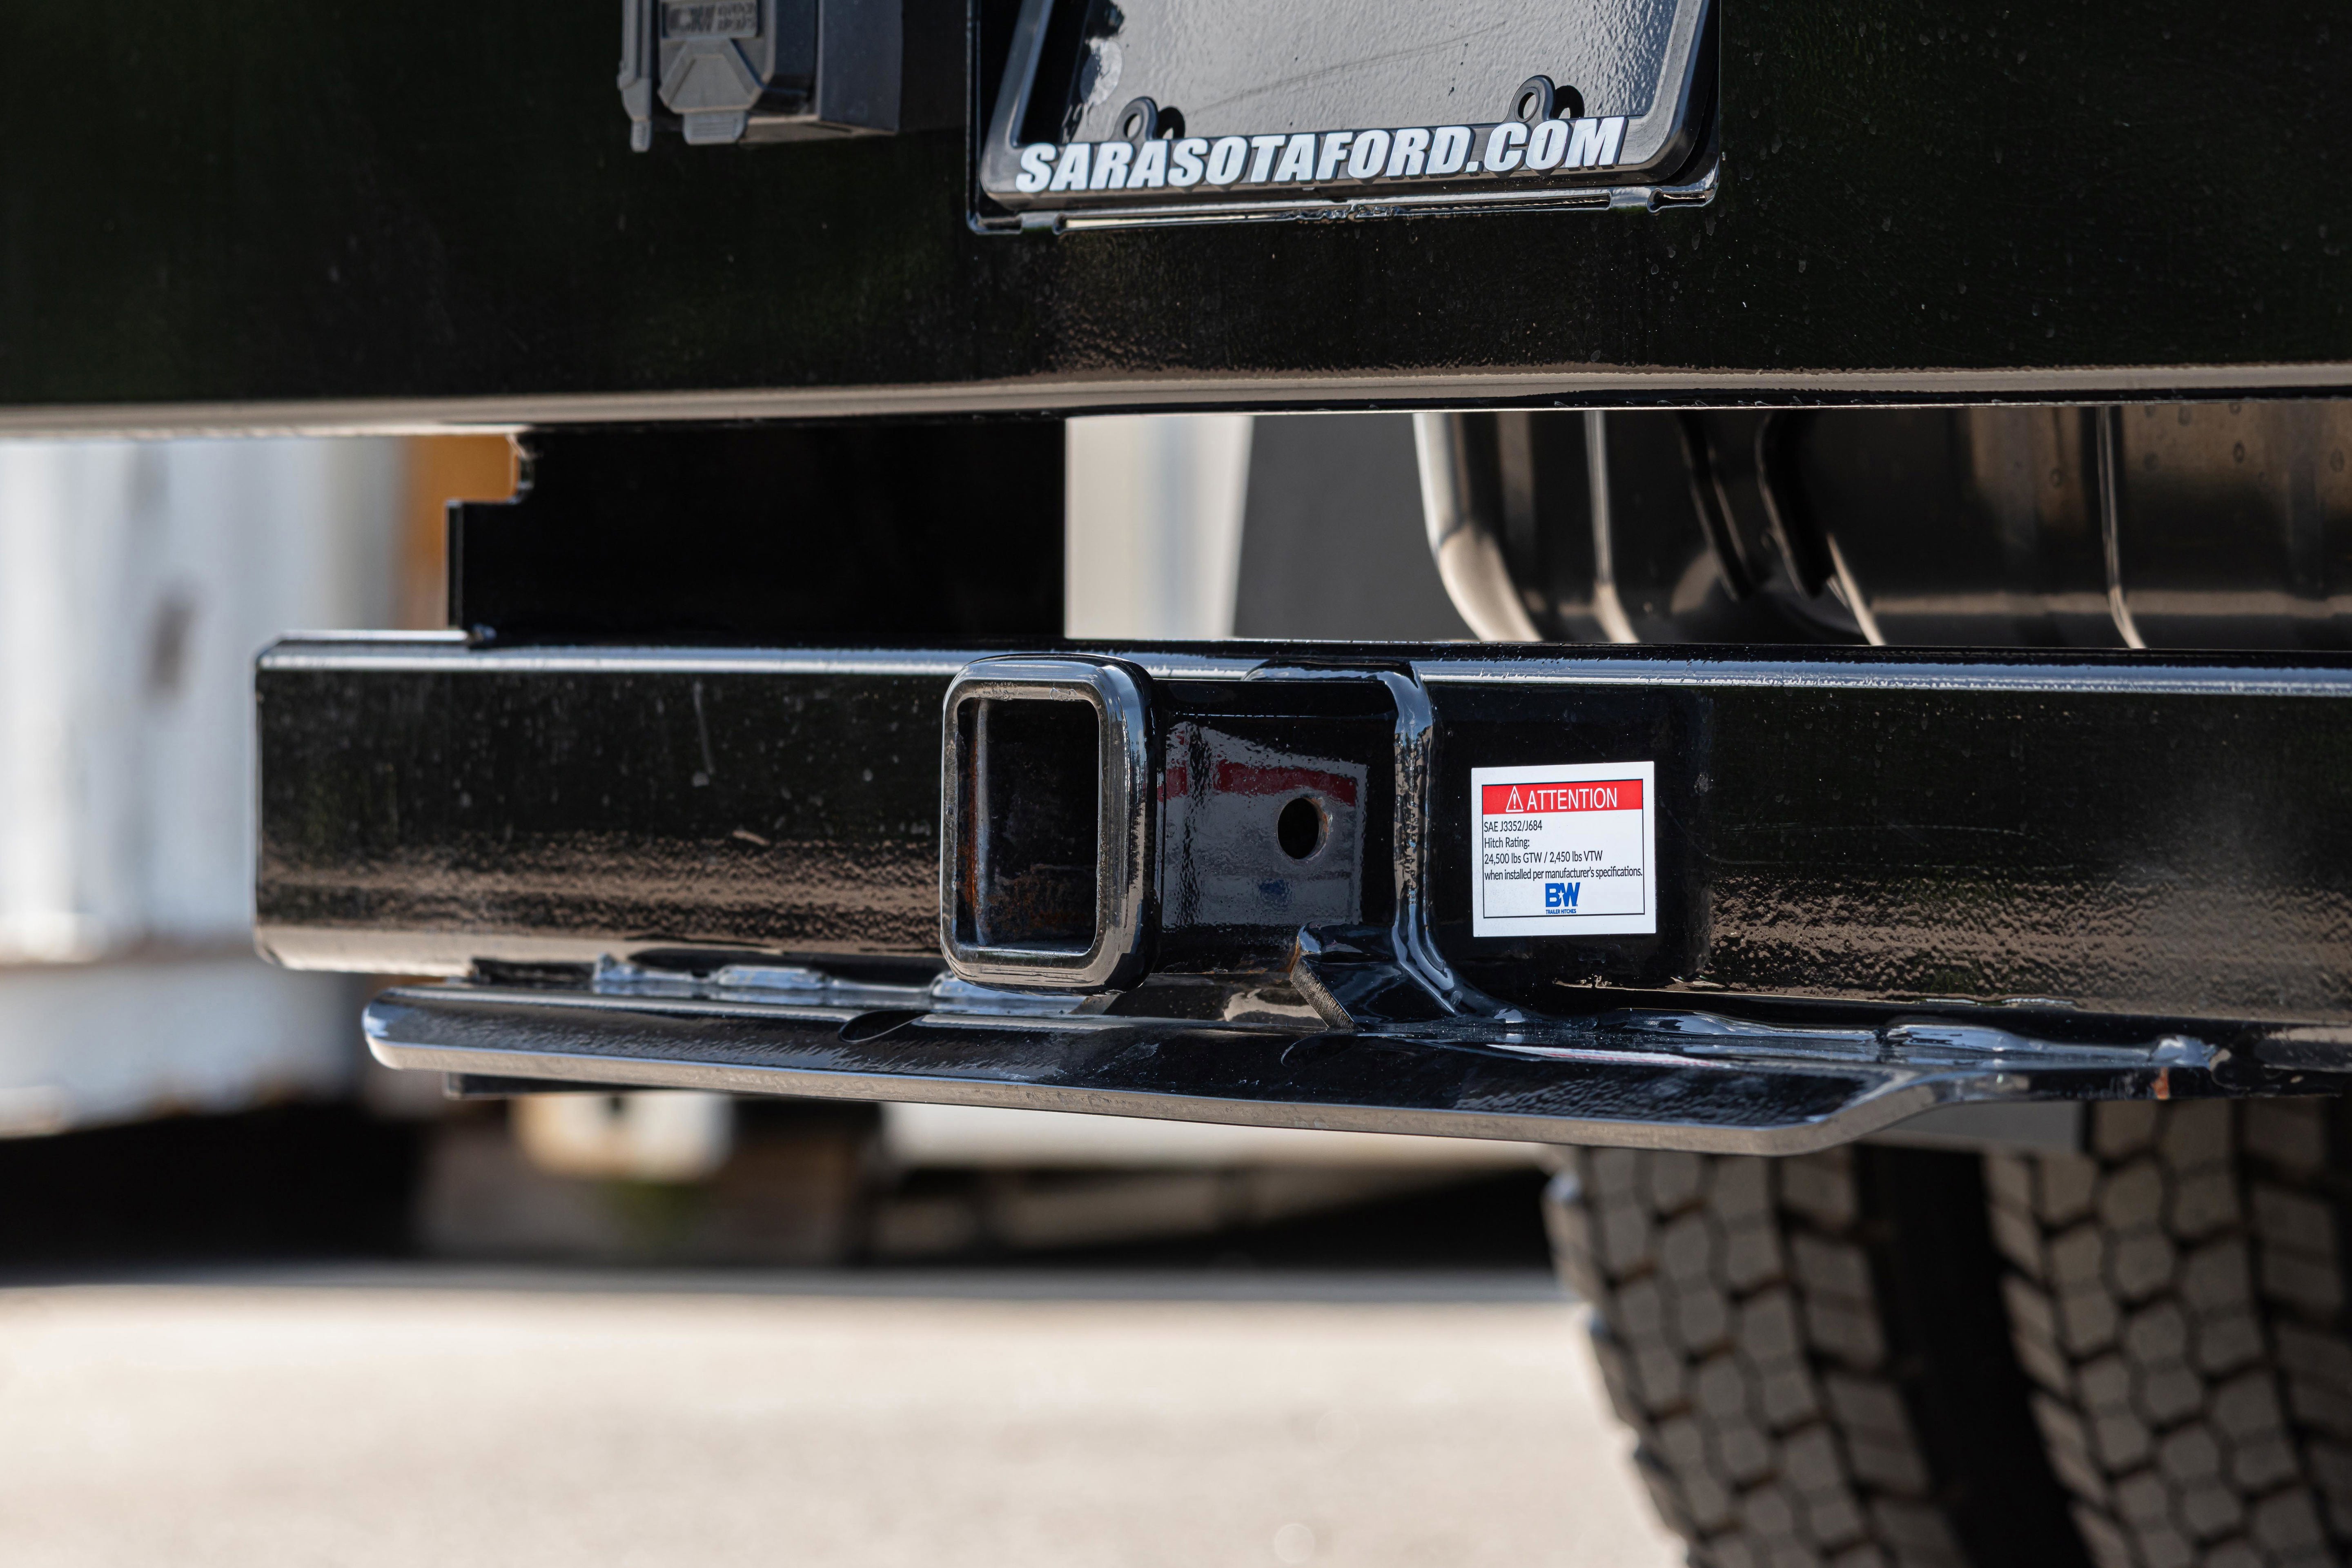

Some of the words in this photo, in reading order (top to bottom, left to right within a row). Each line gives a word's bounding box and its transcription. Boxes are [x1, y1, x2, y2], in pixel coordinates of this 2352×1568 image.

[1015, 116, 1628, 194] SARASOTAFORD.COM
[1527, 787, 1617, 811] ATTENTION
[1484, 821, 1498, 832] SAE
[1500, 820, 1542, 832] J3352/J684
[1484, 837, 1503, 848] Hitch
[1506, 837, 1530, 849] Rating:
[1484, 853, 1509, 866] 24,500
[1512, 853, 1521, 864] lbs
[1523, 852, 1542, 863] GTW
[1544, 852, 1548, 863] /
[1550, 851, 1570, 864] 2,450
[1572, 851, 1582, 862] lbs
[1584, 850, 1603, 861] VTW
[1485, 869, 1503, 880] when
[1505, 869, 1531, 880] installed
[1533, 870, 1544, 881] per
[1546, 866, 1594, 879] manufacturer's
[1596, 866, 1643, 880] specifications.
